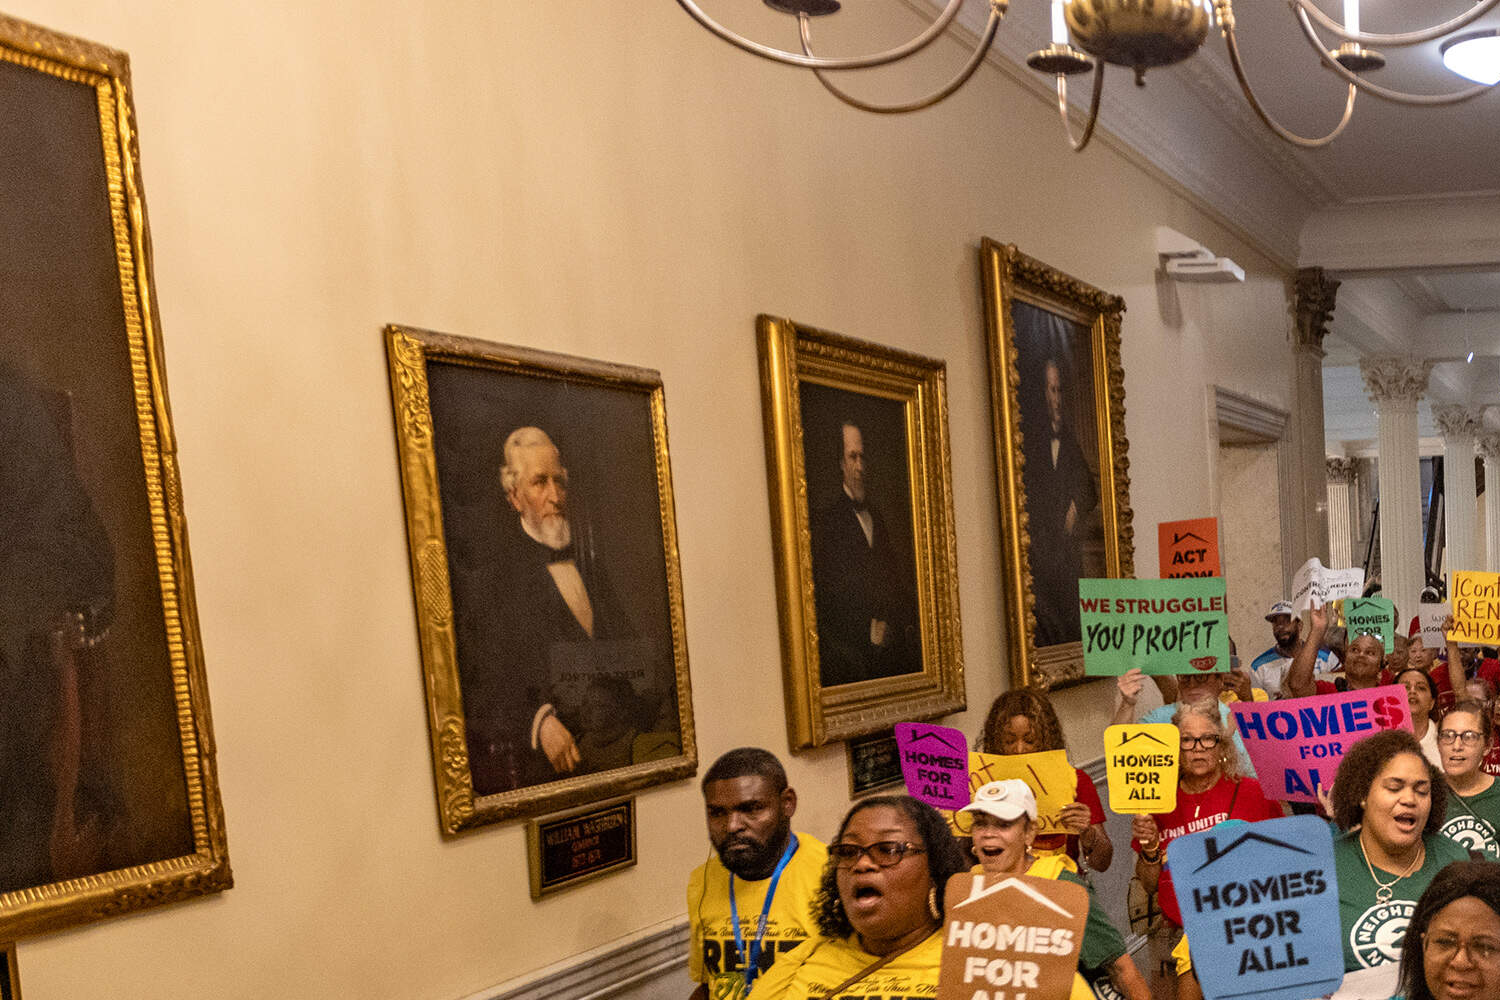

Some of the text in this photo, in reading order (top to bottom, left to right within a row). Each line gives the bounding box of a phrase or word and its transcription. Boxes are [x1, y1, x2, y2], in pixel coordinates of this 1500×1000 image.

[1172, 549, 1207, 565] ACT
[1080, 598, 1111, 613] WE
[1349, 614, 1390, 625] HOMES
[1086, 620, 1219, 655] YOU PROFIT
[1235, 696, 1404, 741] HOMES
[904, 750, 964, 770] HOMES
[1299, 741, 1343, 760] FOR
[1113, 754, 1174, 768] HOMES
[918, 769, 952, 785] FOR
[1125, 771, 1160, 785] FOR
[1284, 769, 1328, 798] AL
[922, 785, 955, 799] ALL
[1128, 787, 1160, 800] ALL
[1159, 825, 1185, 842] LYNN
[1443, 820, 1490, 839] IGHBOR
[1192, 870, 1327, 913] HOMES
[1223, 910, 1301, 944] FOR
[1358, 905, 1414, 942] NEIGHB
[948, 920, 1074, 957] HOMES
[1237, 945, 1309, 976] ALL
[963, 956, 1040, 988] FOR
